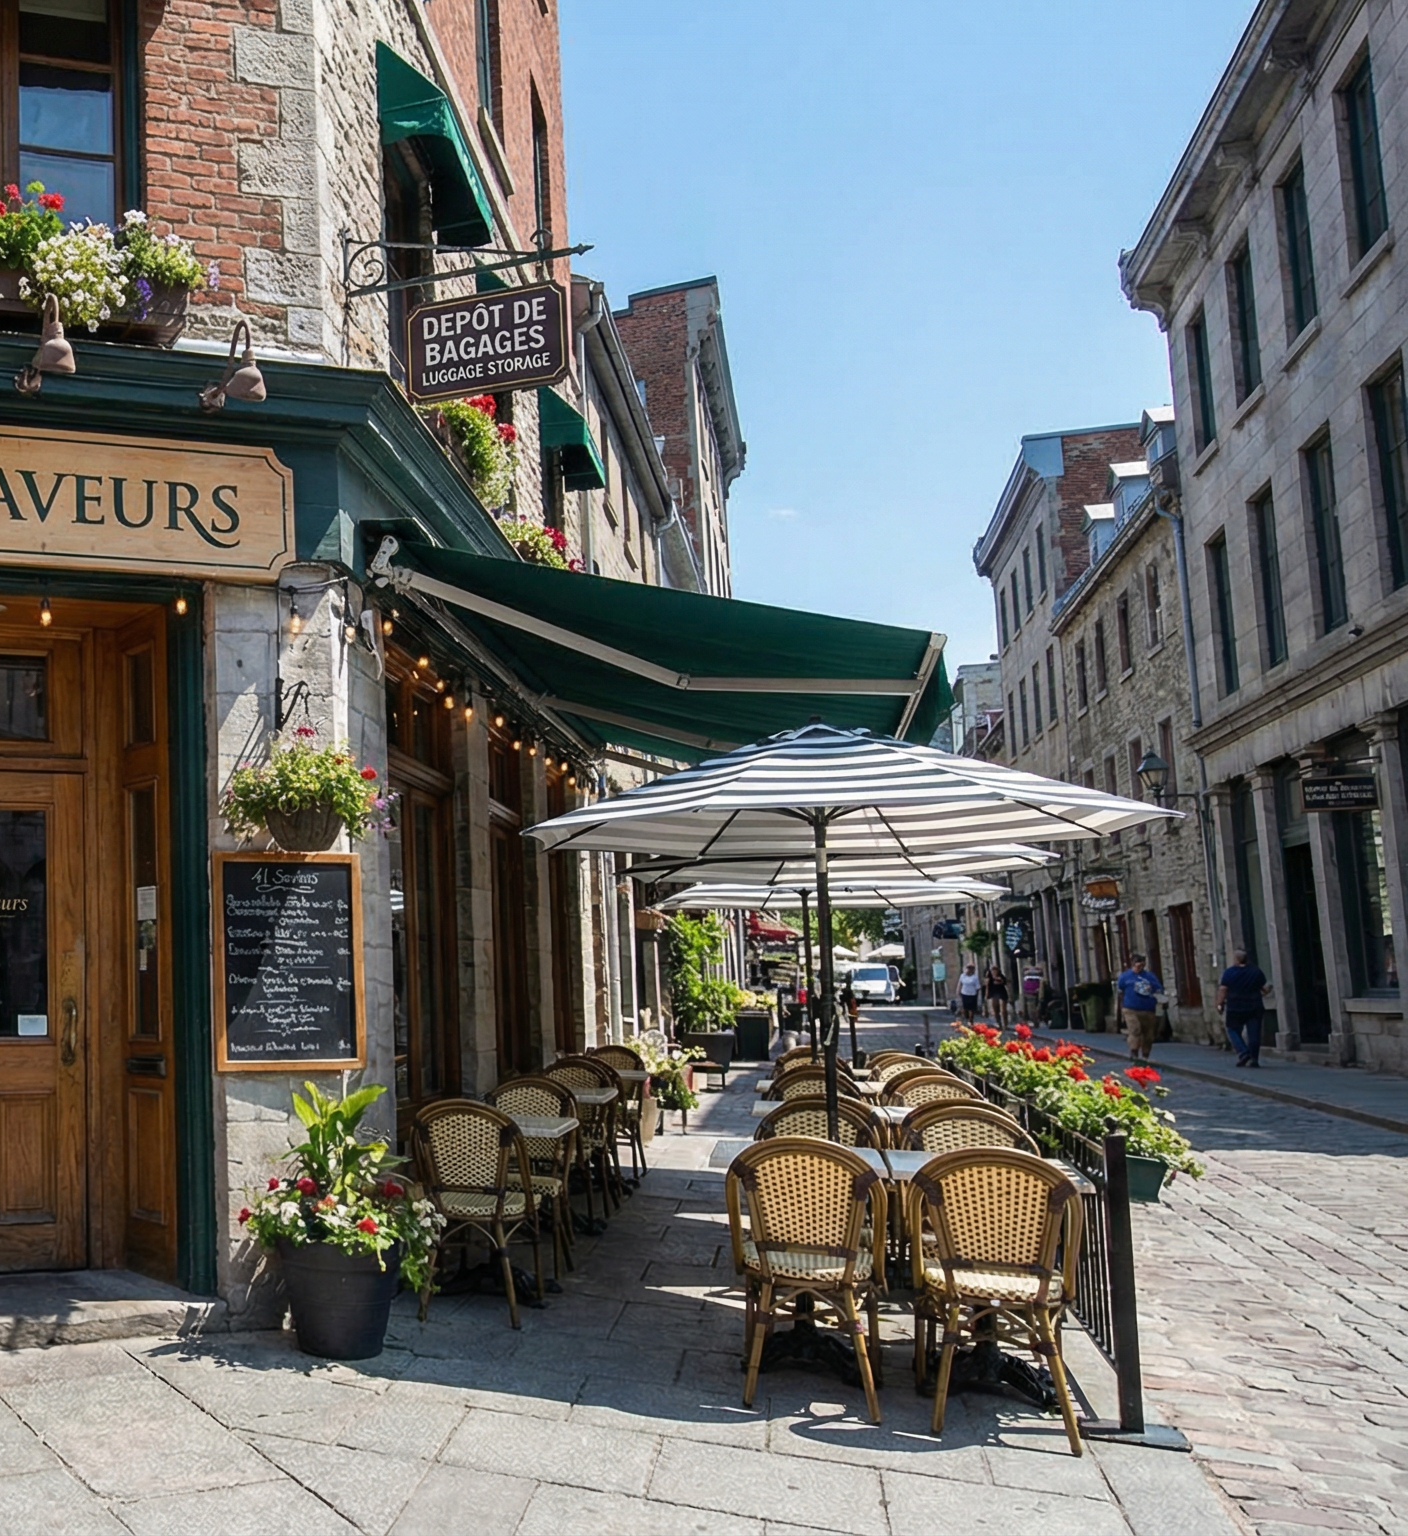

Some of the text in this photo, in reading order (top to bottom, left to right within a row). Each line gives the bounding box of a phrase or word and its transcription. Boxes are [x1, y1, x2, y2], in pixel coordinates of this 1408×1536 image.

[422, 296, 547, 340] DEPÔT DE
[425, 325, 546, 367] BAGAGES
[421, 352, 551, 387] LUGGAGE STORAGE
